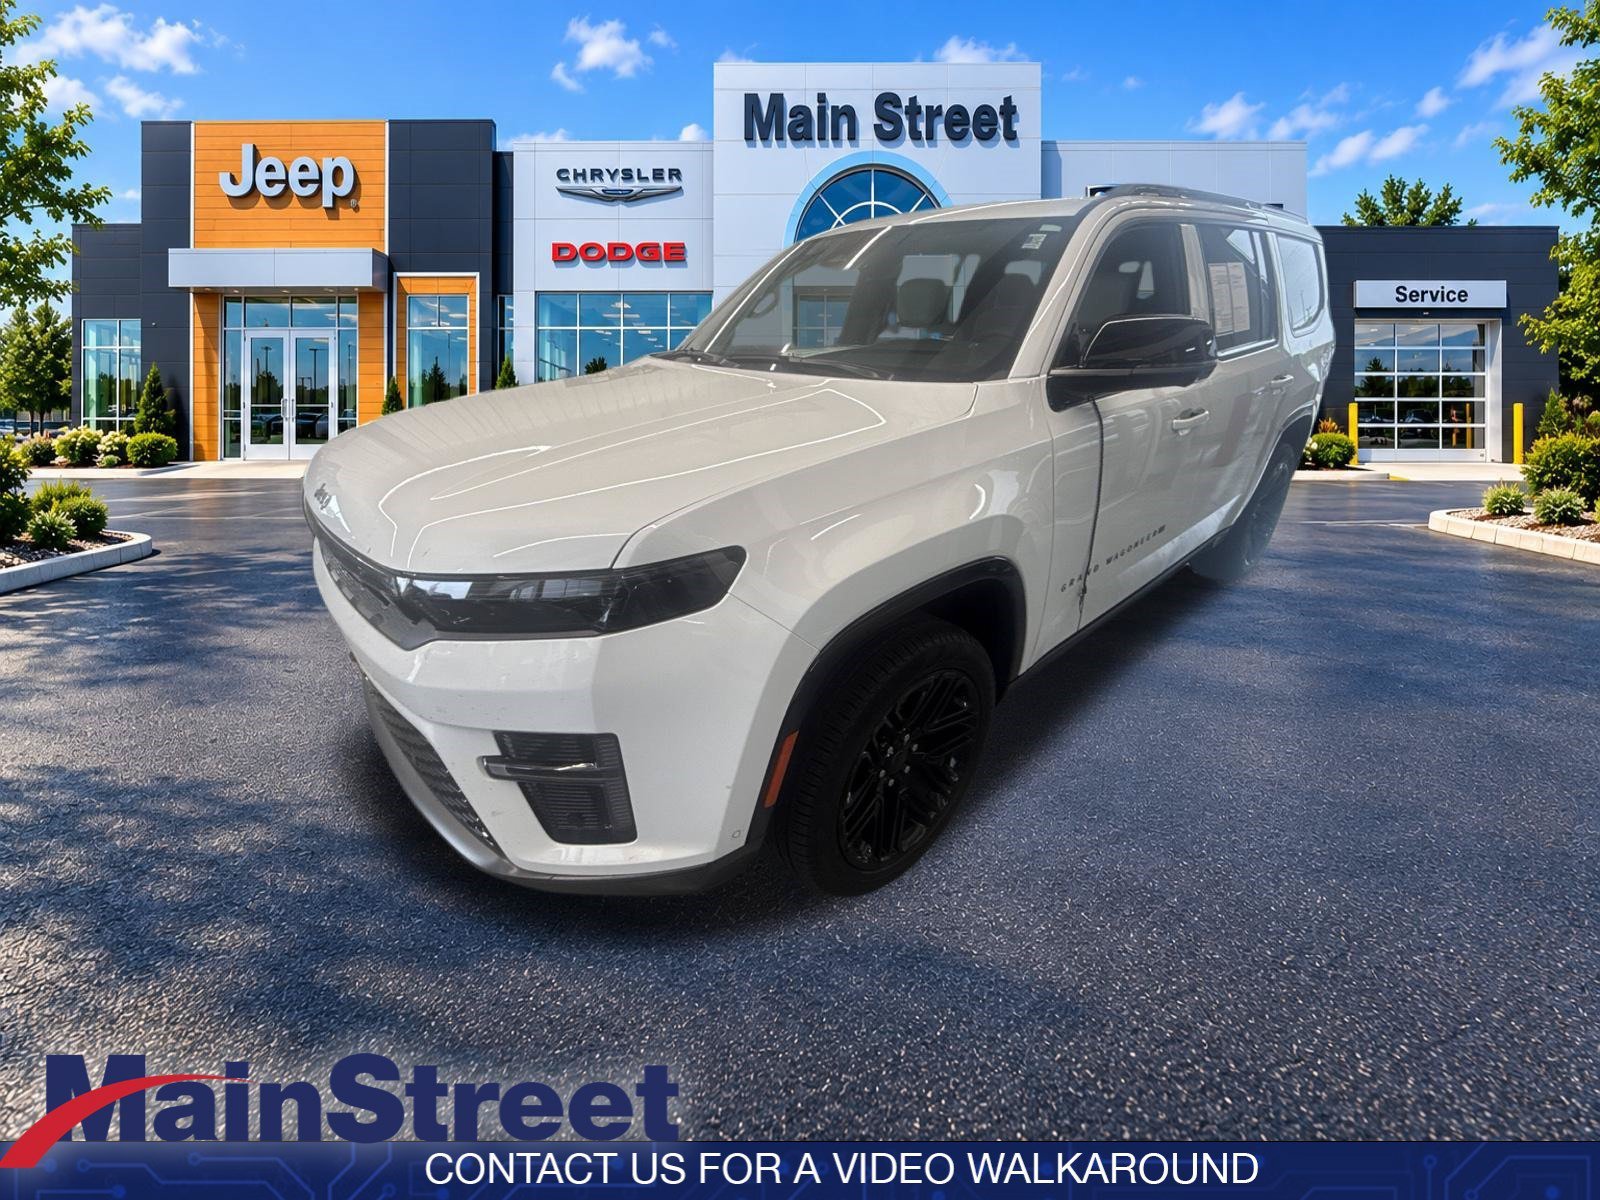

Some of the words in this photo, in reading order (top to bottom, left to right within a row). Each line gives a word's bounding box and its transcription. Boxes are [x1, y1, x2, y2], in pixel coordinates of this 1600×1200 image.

[743, 92, 857, 142] Main
[873, 91, 1018, 142] Street
[218, 143, 356, 209] Jeep
[555, 167, 683, 183] CHRYSLER
[551, 242, 686, 262] DODGE
[1395, 285, 1469, 303] Service
